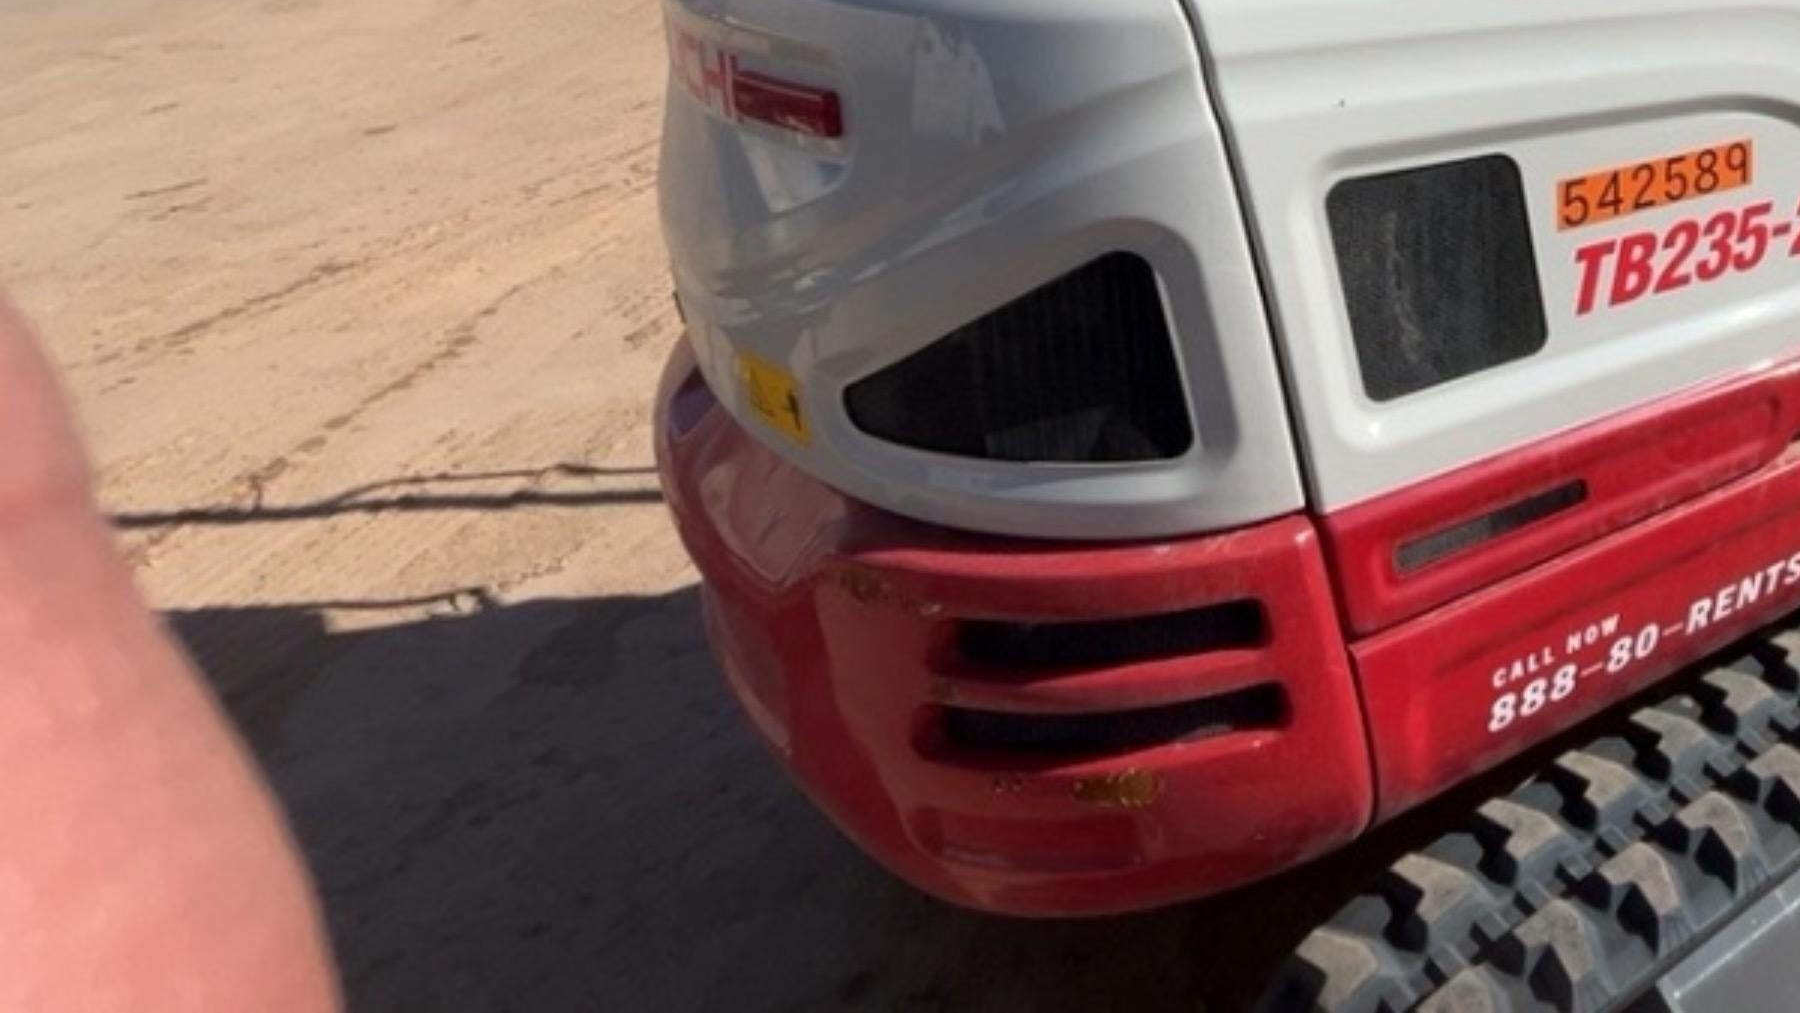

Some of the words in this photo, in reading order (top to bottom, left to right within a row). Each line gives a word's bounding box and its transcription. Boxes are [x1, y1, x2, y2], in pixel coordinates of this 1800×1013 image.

[1561, 141, 1749, 228] 542589
[1491, 646, 1556, 689] CALL
[1565, 612, 1622, 655] NOW
